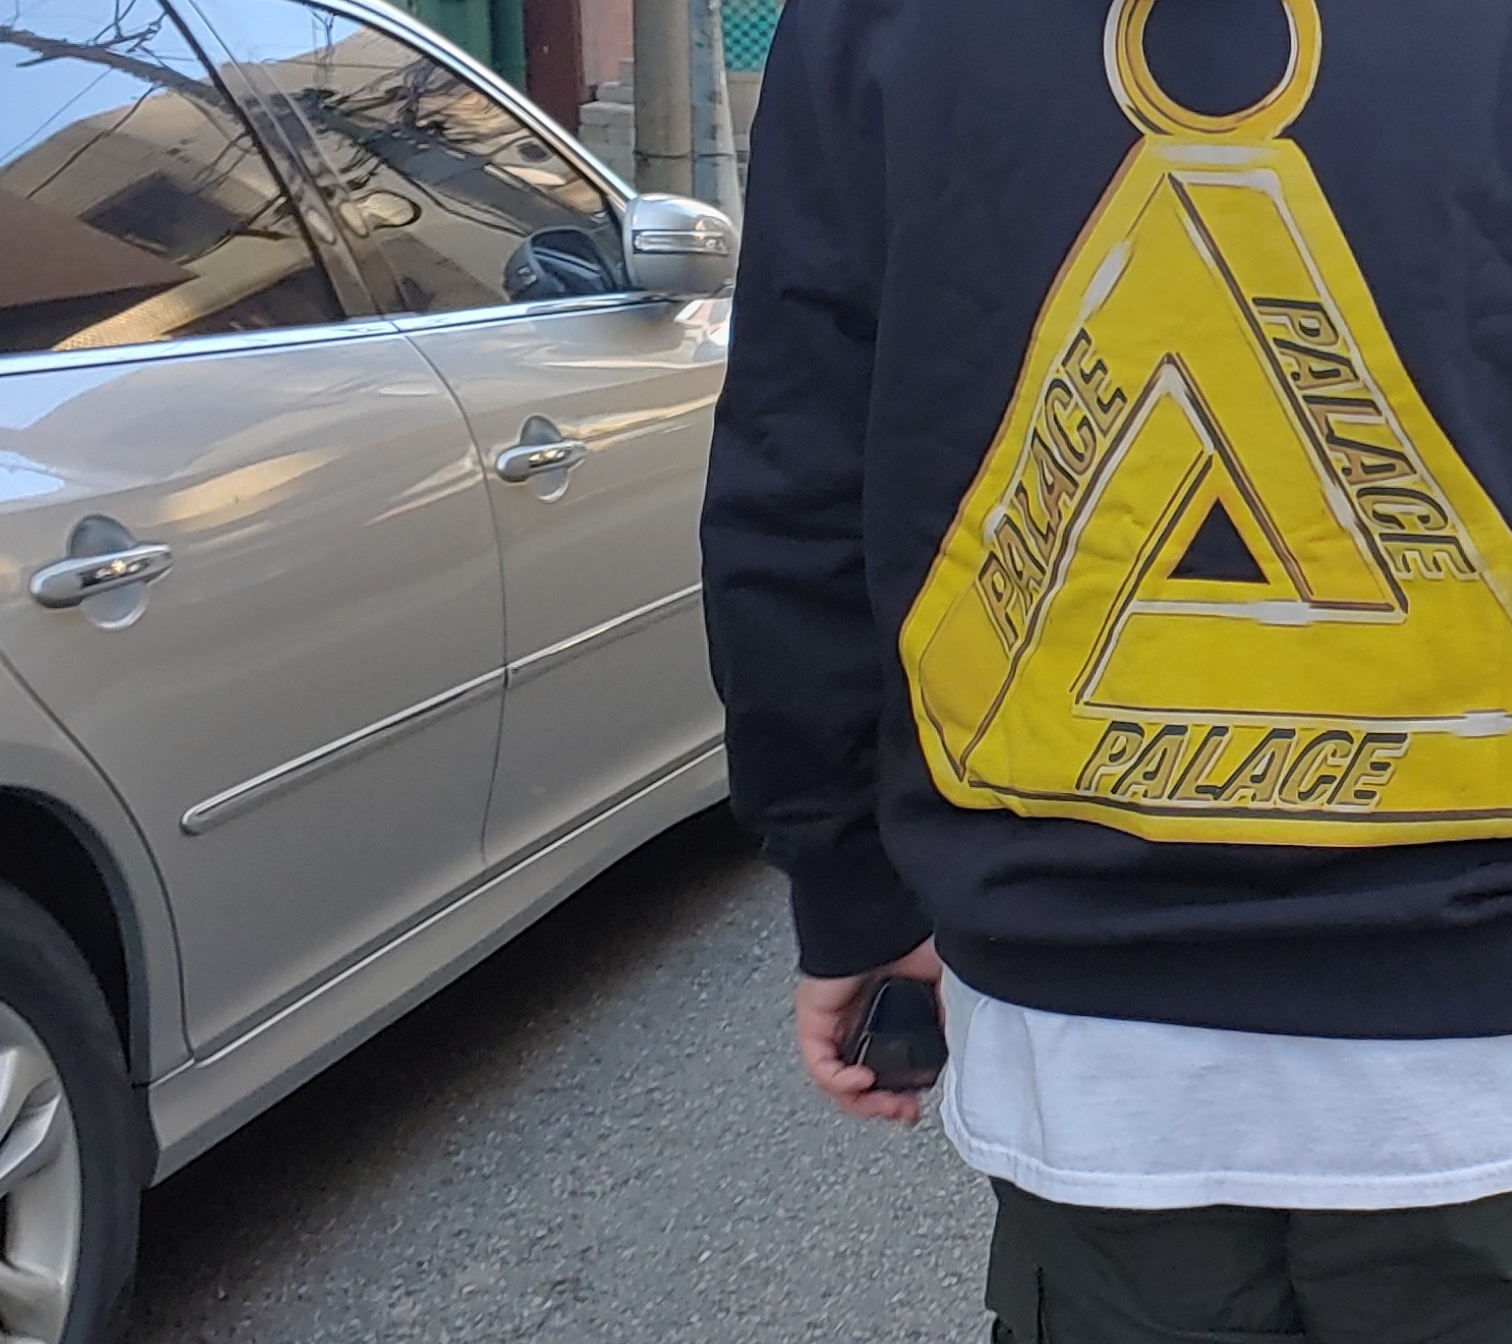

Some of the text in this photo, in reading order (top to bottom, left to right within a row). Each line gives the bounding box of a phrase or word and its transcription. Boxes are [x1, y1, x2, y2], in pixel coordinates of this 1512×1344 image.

[975, 327, 1128, 650] PALACE
[1251, 296, 1480, 582] PALACE
[1075, 720, 1410, 811] PALACE
